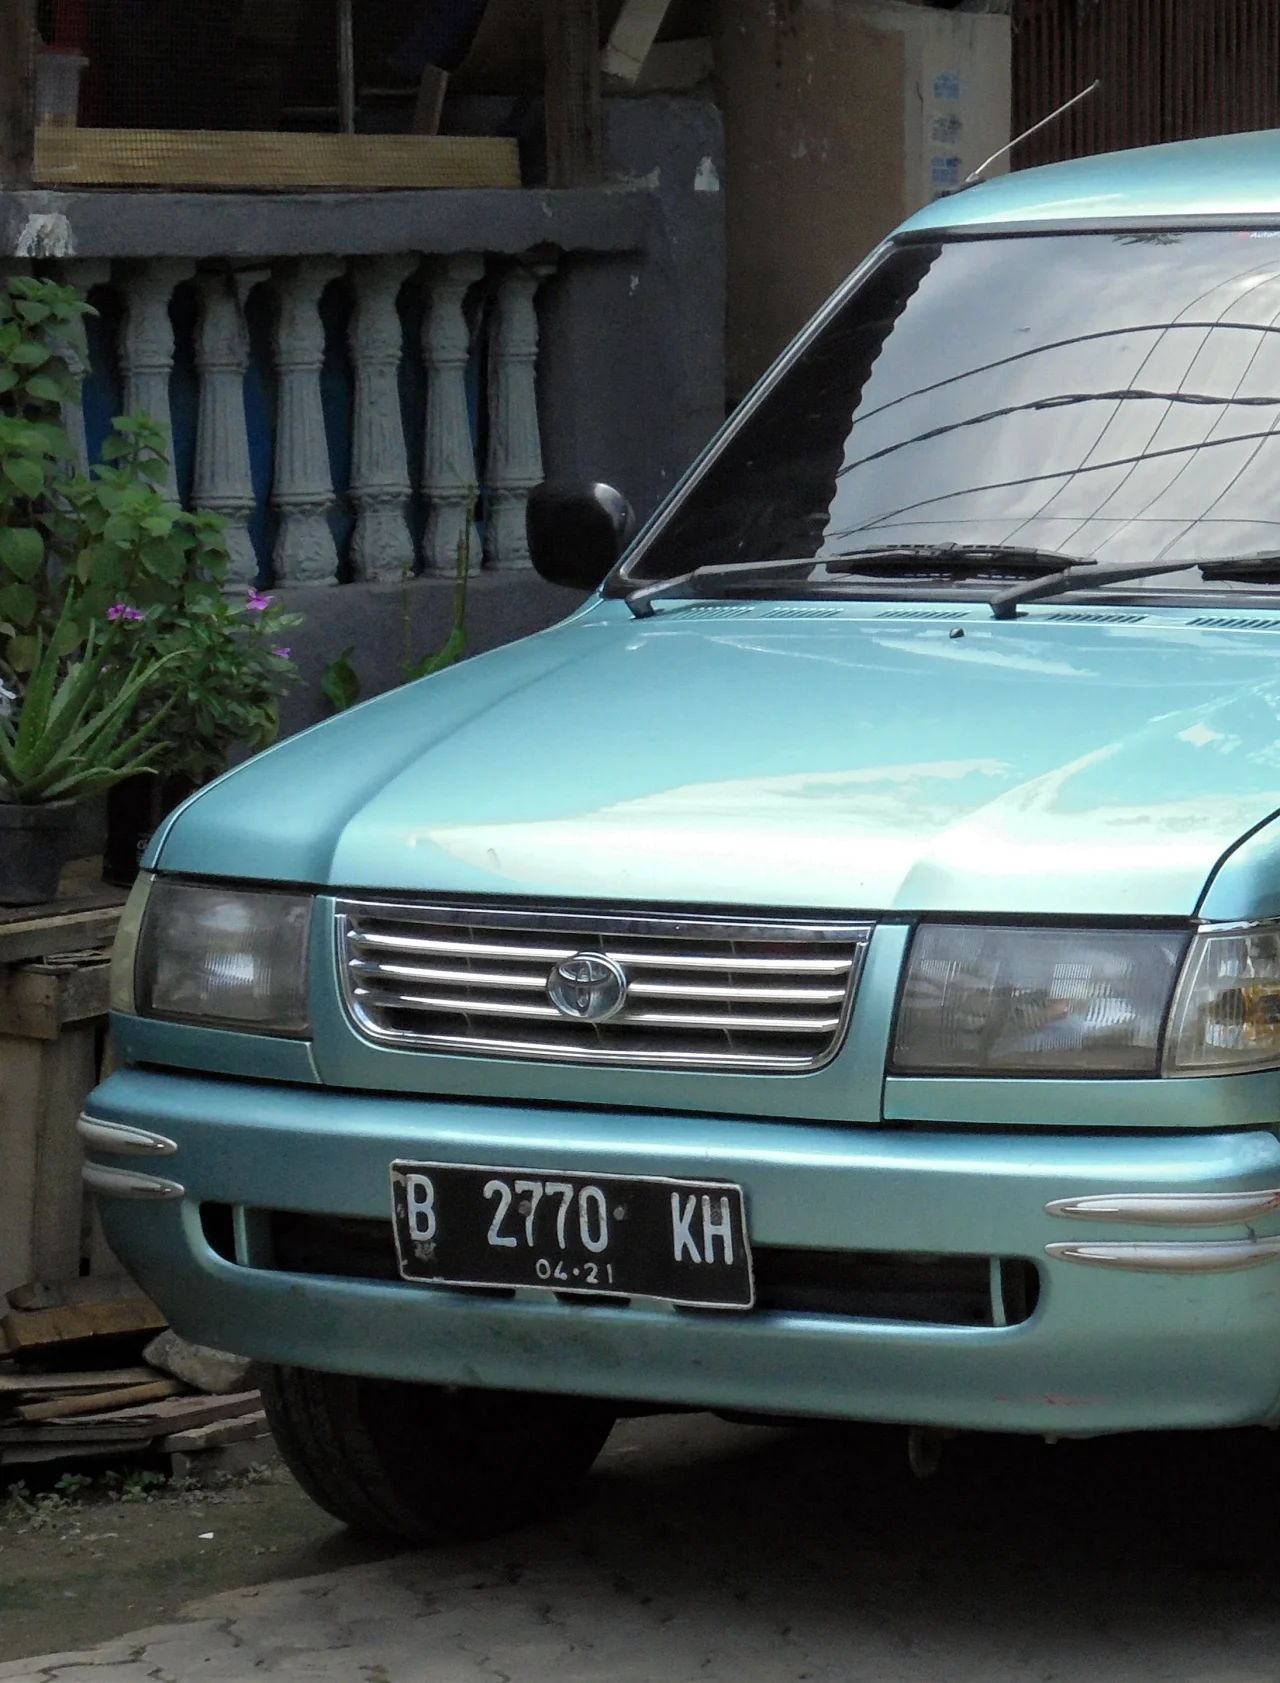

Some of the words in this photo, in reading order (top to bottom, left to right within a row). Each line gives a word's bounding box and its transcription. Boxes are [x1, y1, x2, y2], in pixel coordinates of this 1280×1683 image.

[405, 1173, 437, 1242] B
[483, 1179, 609, 1253] 2770
[670, 1191, 734, 1266] KH
